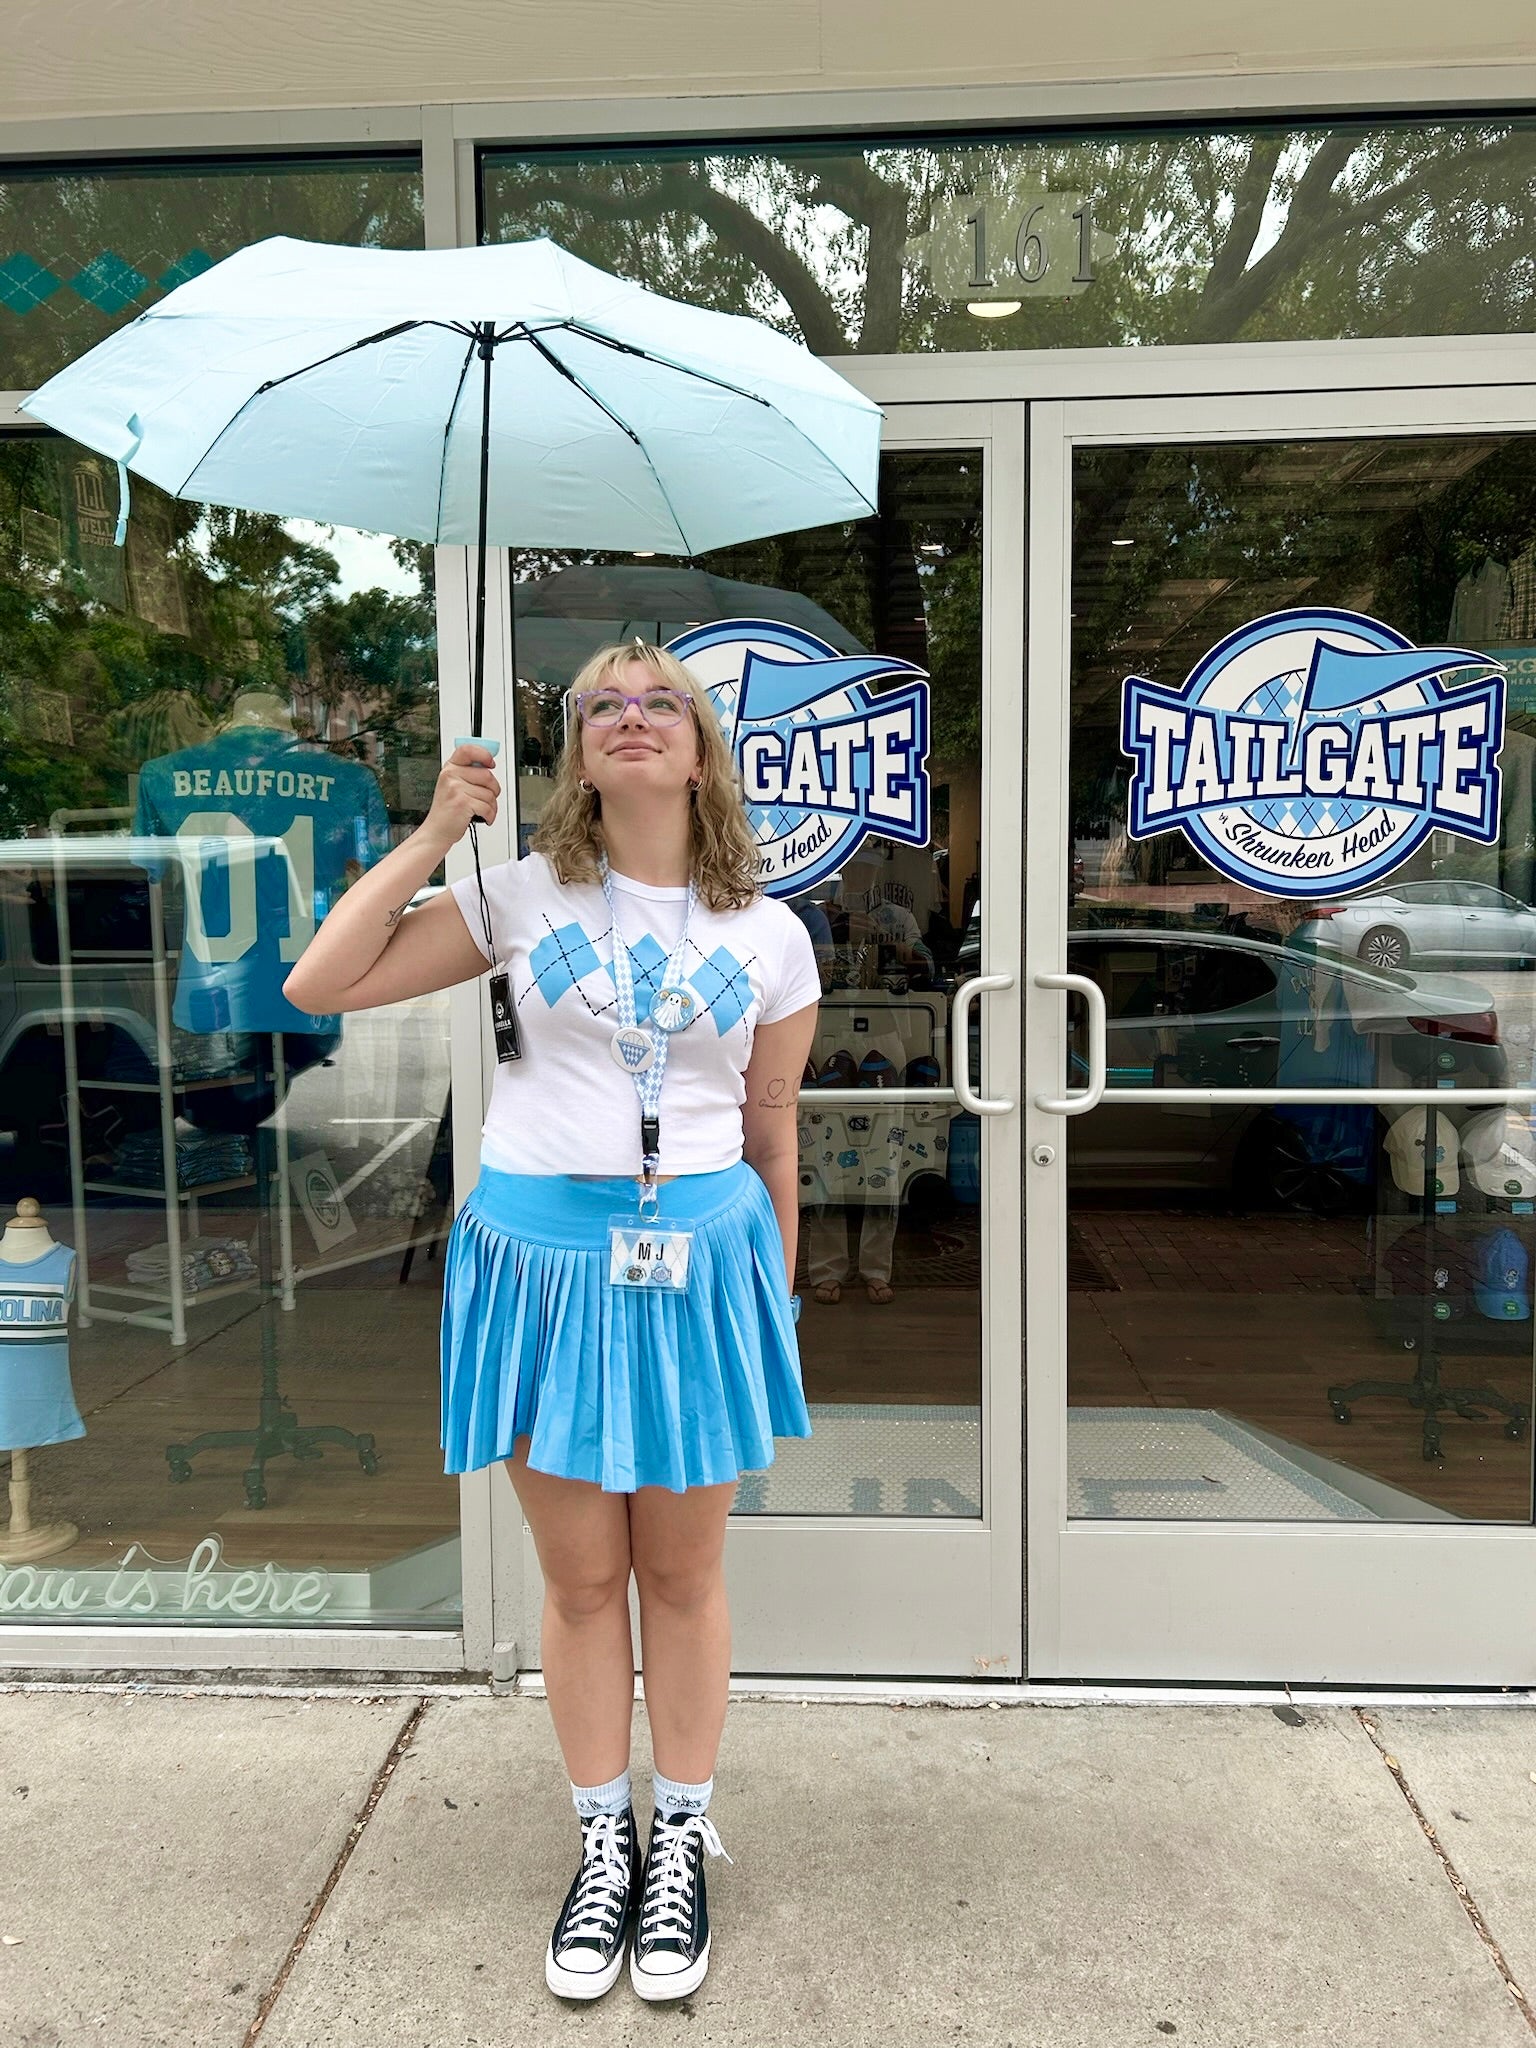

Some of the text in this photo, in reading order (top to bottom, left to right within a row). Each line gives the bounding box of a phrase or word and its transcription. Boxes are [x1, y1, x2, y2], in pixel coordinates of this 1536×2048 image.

[967, 201, 1096, 287] 161
[173, 769, 335, 802] BEAUFORT
[743, 707, 912, 822] GATE
[1139, 701, 1487, 819] TAILGATE
[781, 815, 832, 869] Head
[1218, 808, 1397, 869] by Shrunken Head
[176, 812, 315, 963] 01
[884, 882, 914, 912] HEELS
[0, 1299, 63, 1322] OLINA
[104, 1545, 158, 1612] is
[182, 1537, 331, 1615] here
